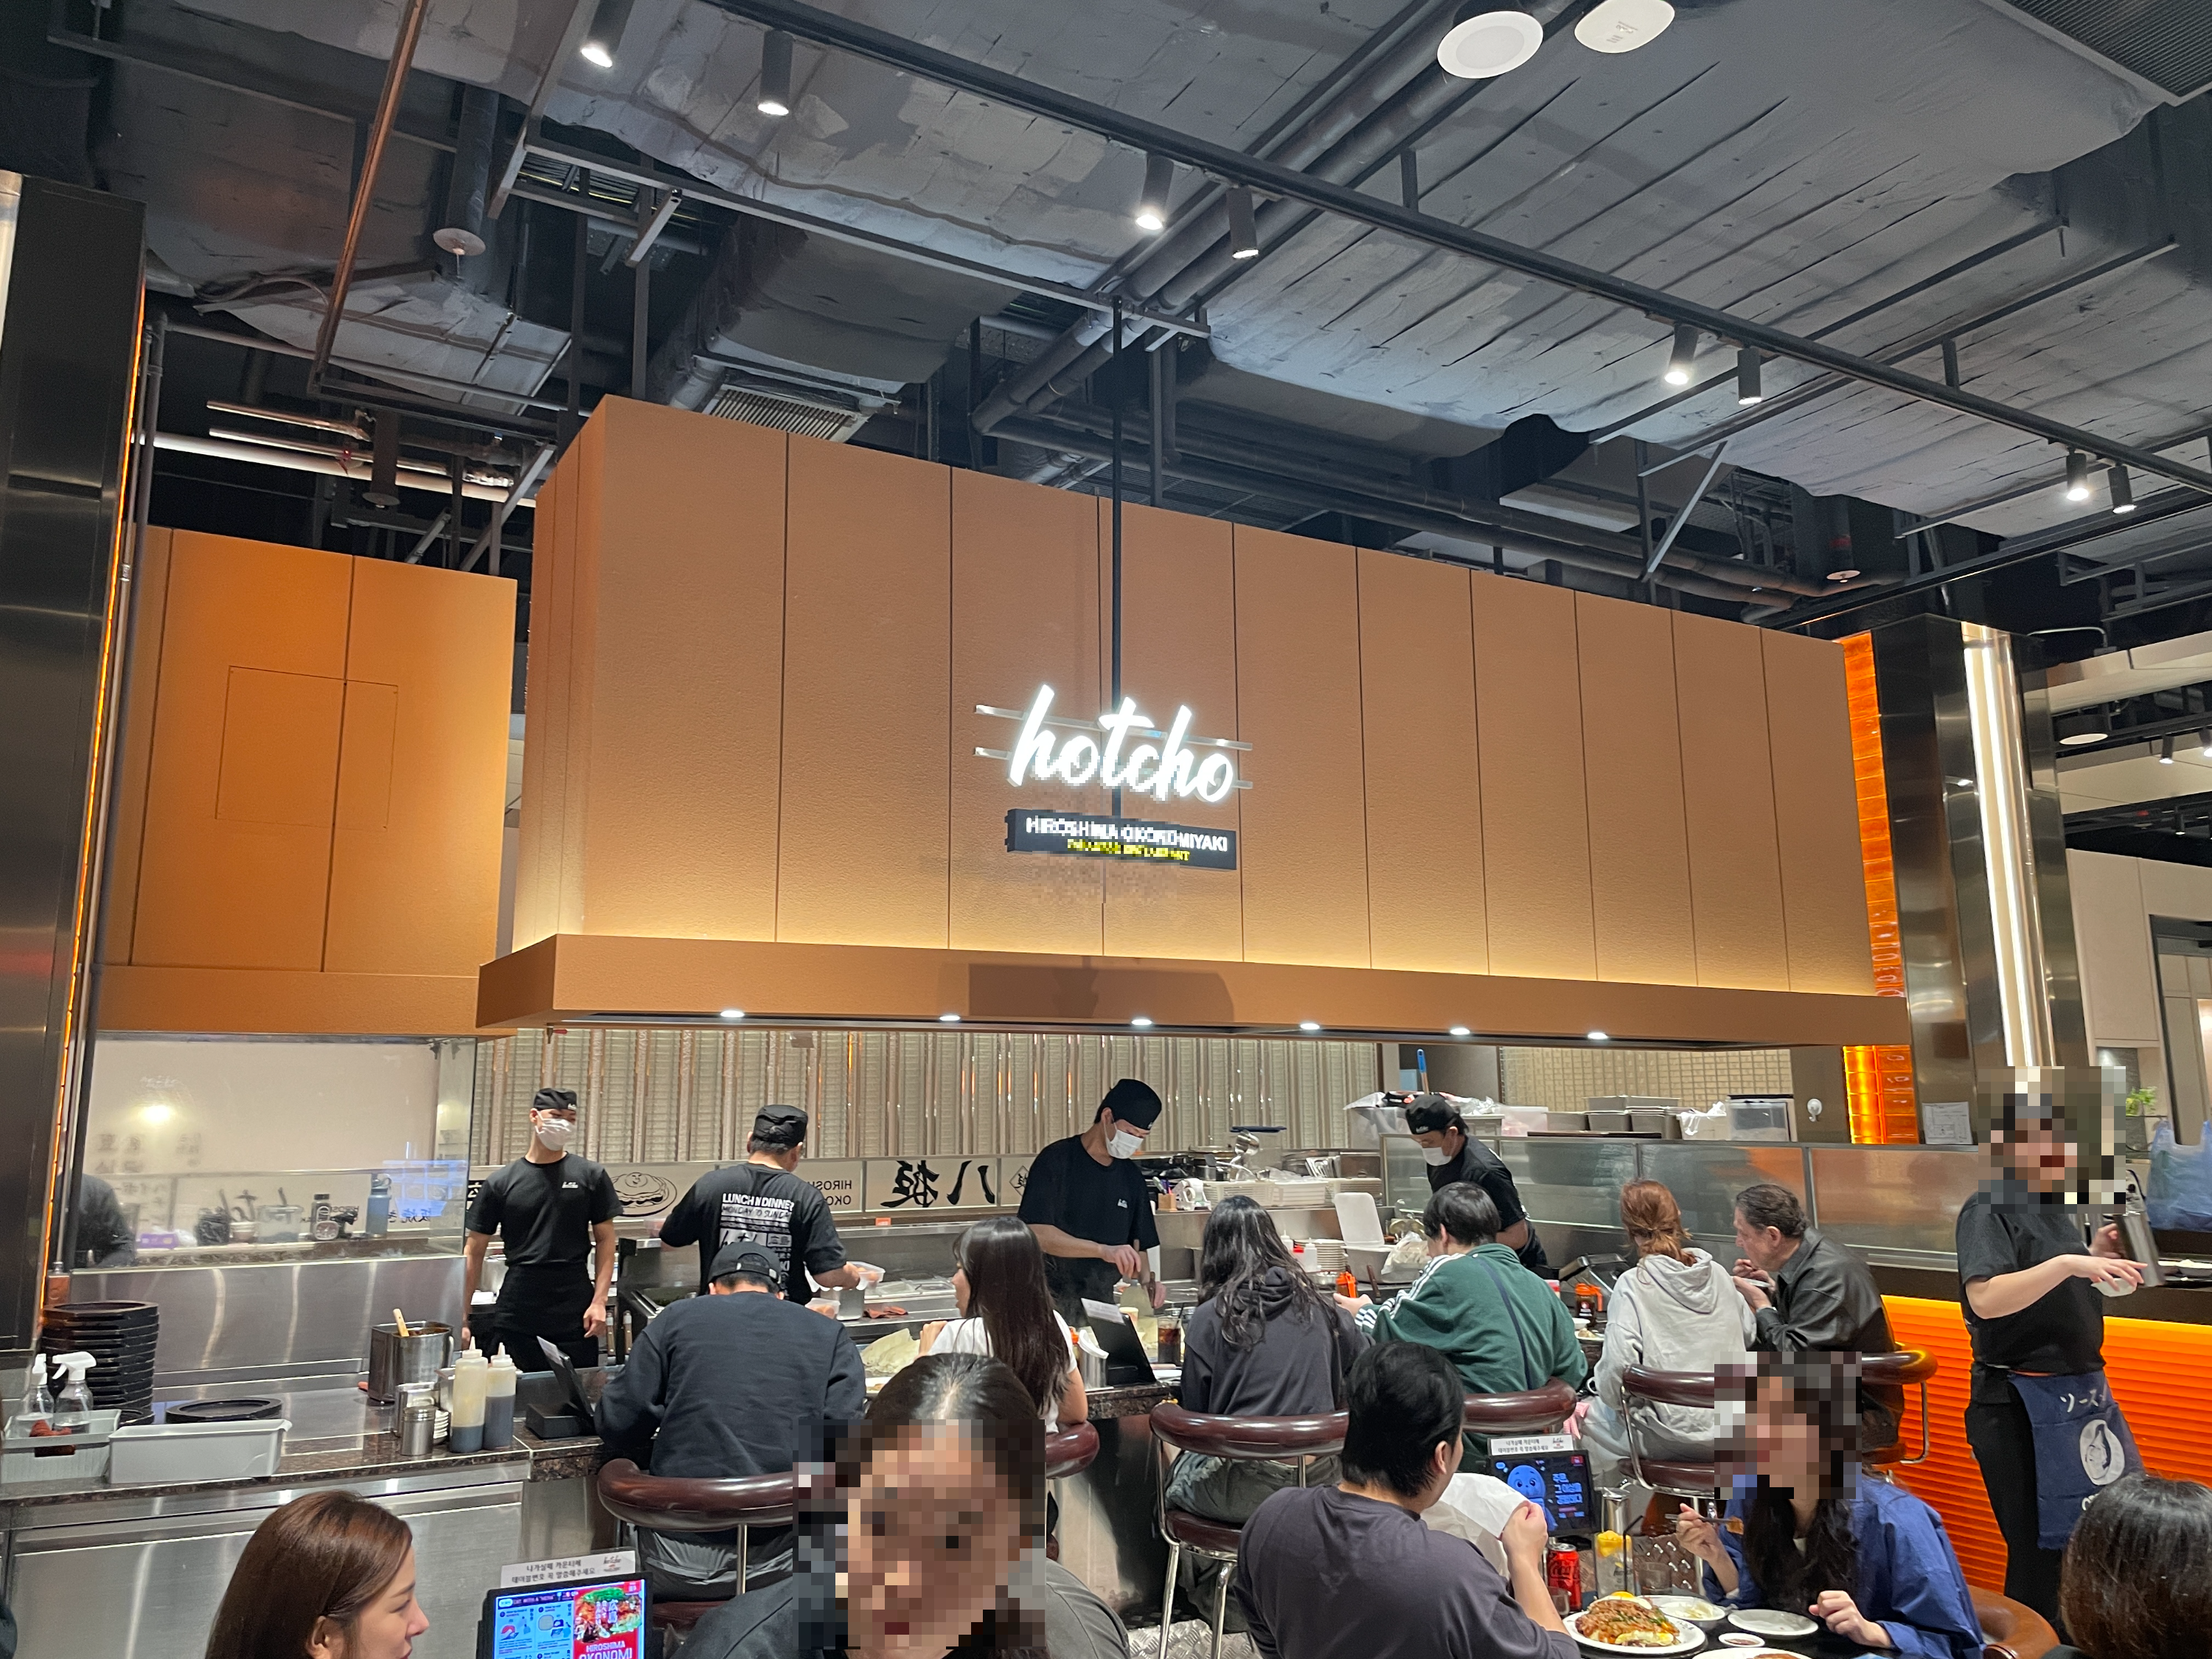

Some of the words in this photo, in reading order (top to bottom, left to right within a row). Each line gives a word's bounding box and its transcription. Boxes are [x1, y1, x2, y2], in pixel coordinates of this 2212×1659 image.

[1007, 684, 1234, 802] hotcho
[722, 1192, 754, 1206] LUNCH
[754, 1196, 762, 1206] N
